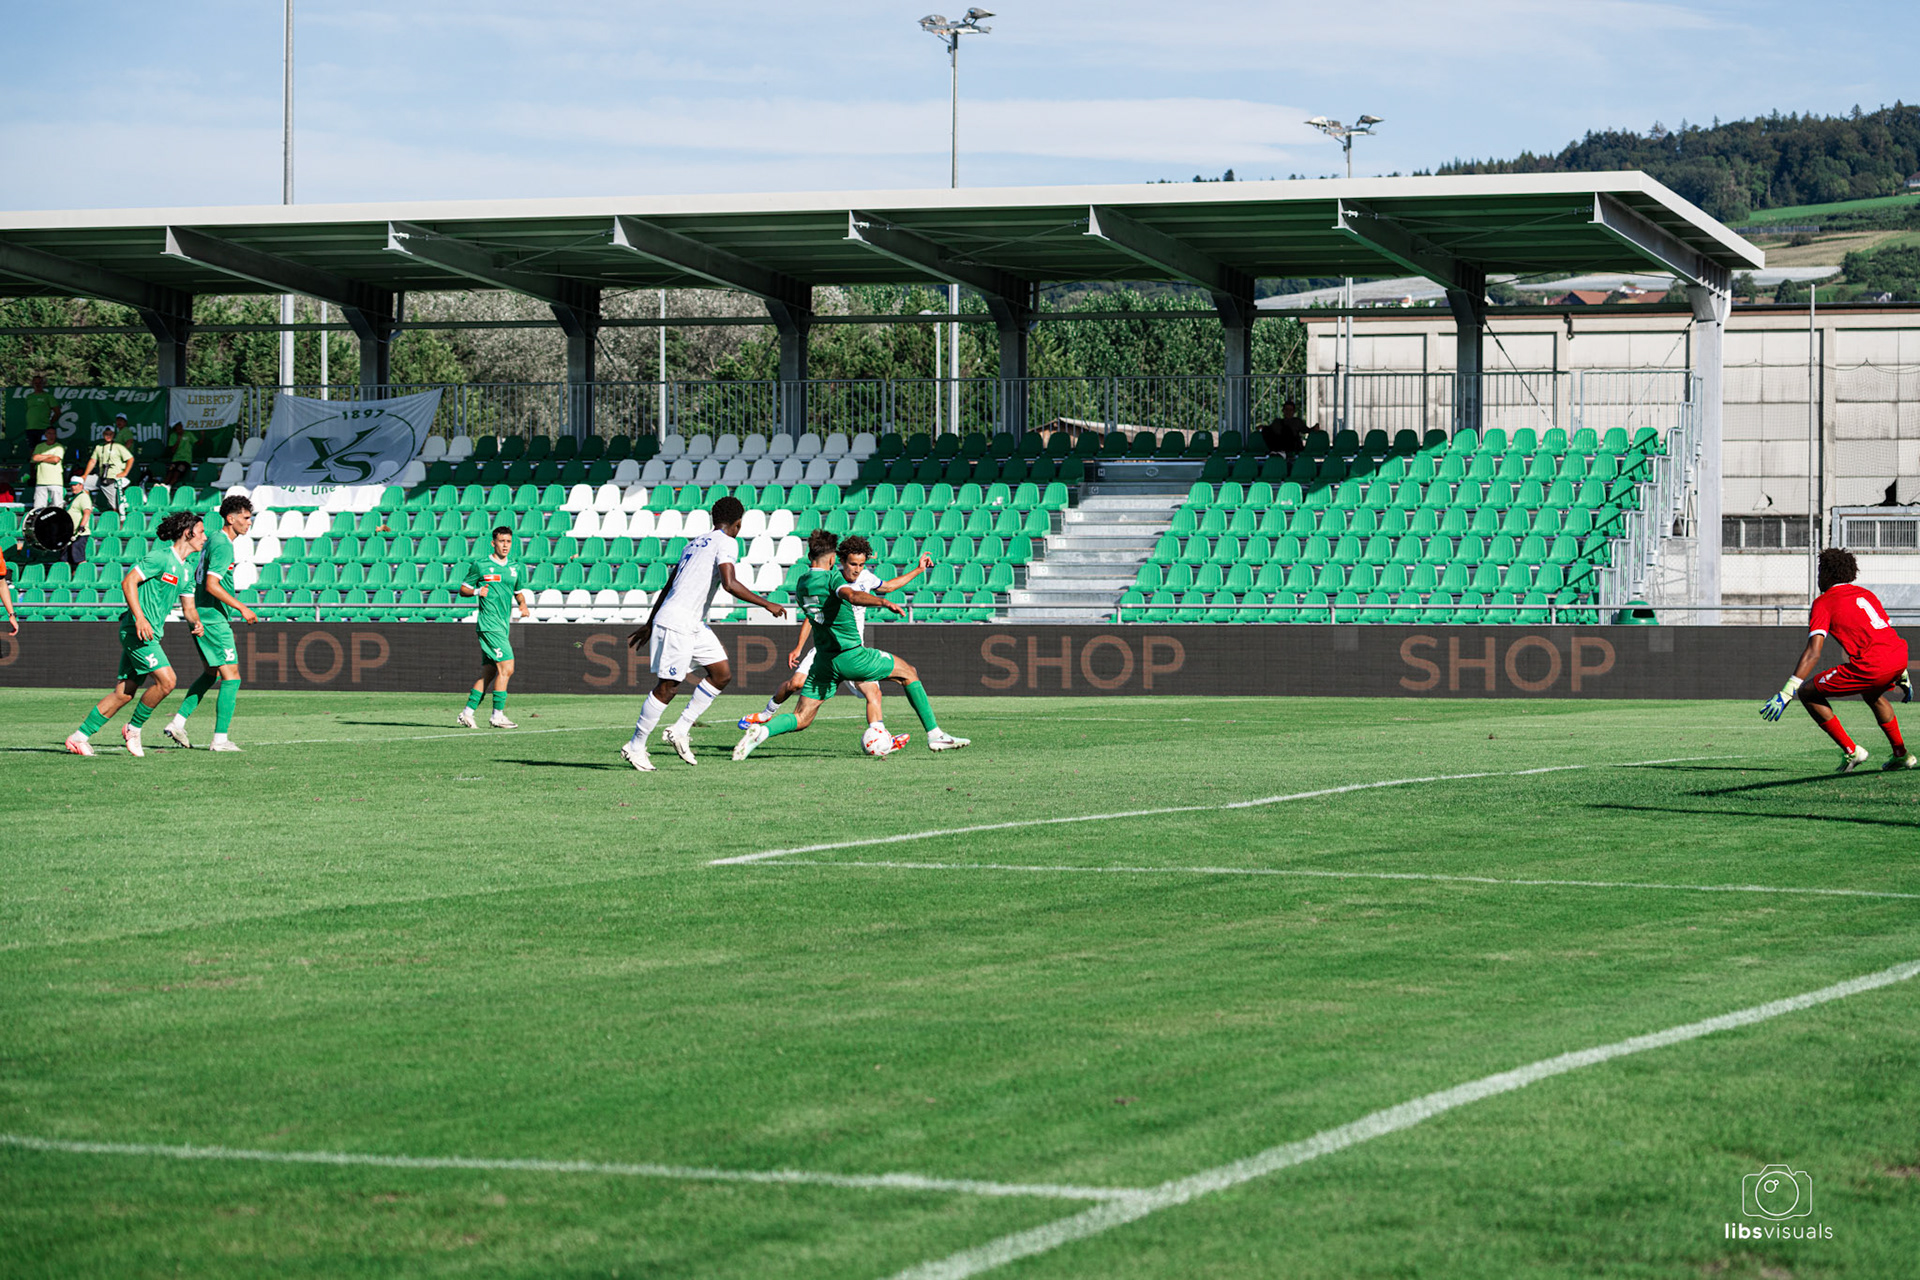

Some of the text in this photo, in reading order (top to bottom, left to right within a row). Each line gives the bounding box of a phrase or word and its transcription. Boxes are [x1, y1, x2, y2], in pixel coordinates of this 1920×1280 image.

[53, 386, 161, 403] Verts-Play
[203, 408, 217, 417] ET
[342, 409, 385, 420] 1897
[1856, 597, 1889, 630] 1
[247, 631, 390, 683] HOP
[583, 633, 778, 688] SHP
[981, 634, 1186, 690] SHOP
[1399, 635, 1616, 692] SHOP
